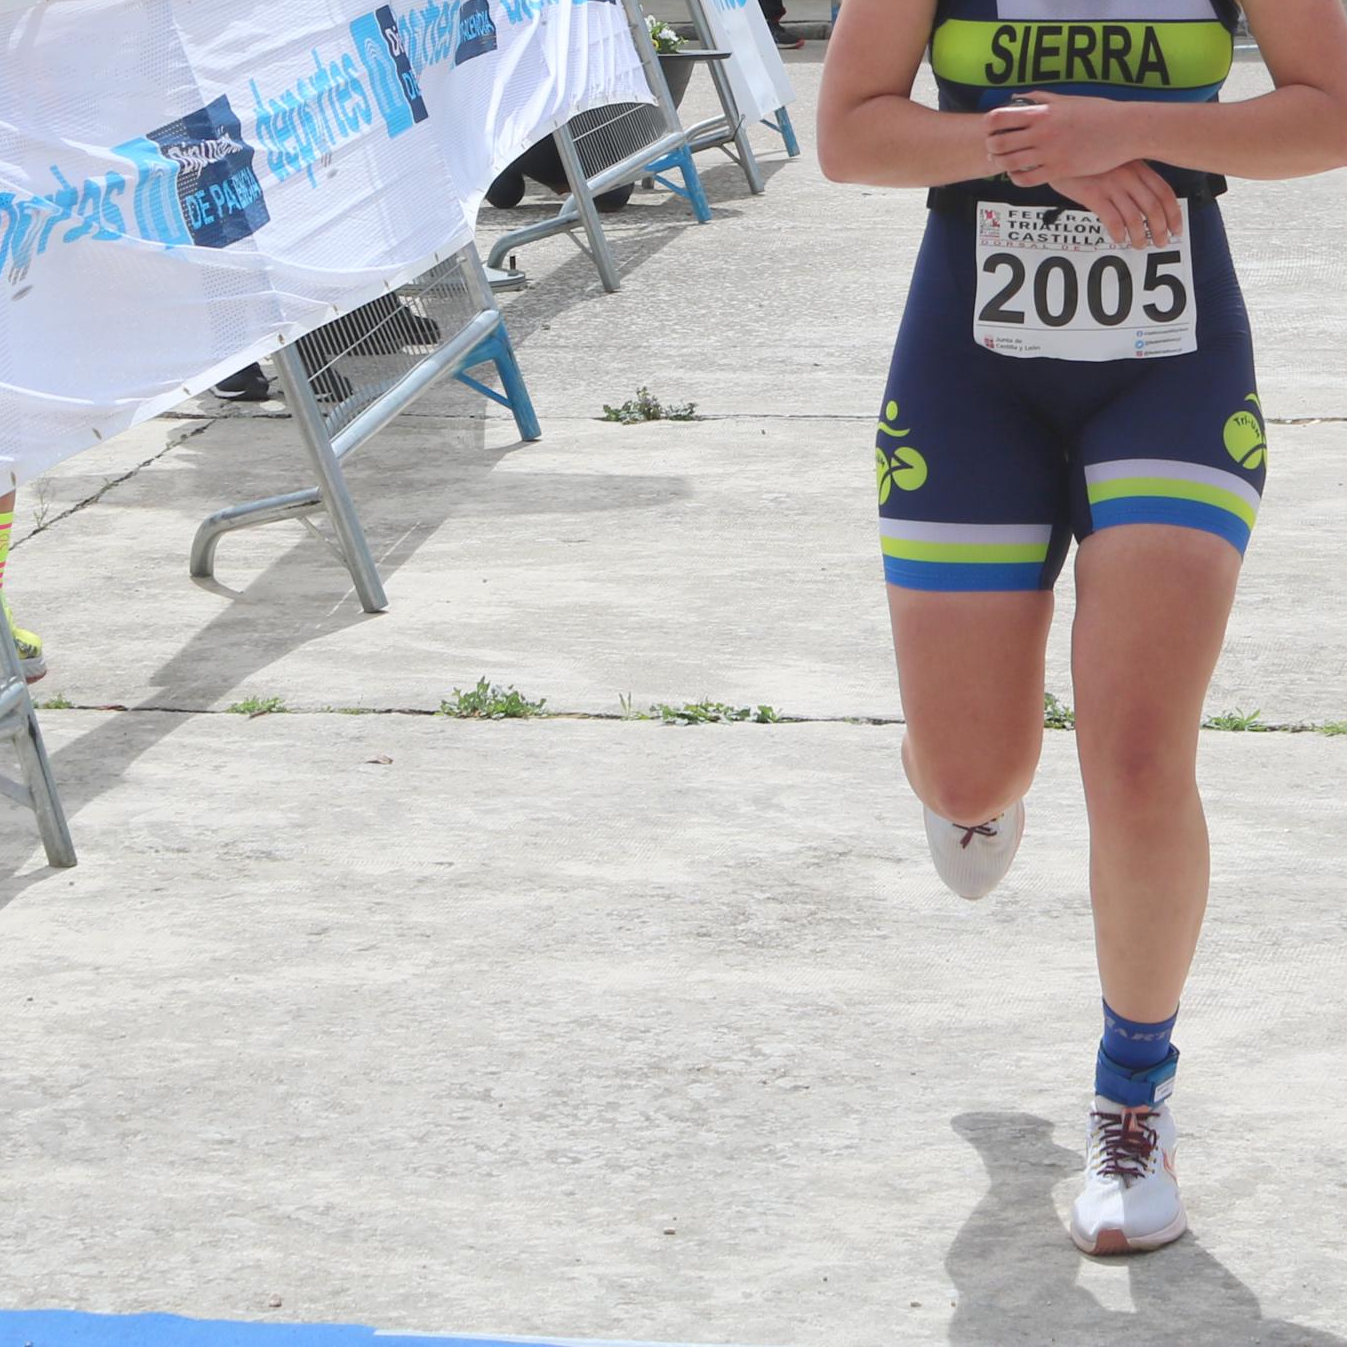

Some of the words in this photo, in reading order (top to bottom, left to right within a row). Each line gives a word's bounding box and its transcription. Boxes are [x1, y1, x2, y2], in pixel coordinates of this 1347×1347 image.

[985, 25, 1171, 85] SIERRA
[1007, 231, 1106, 246] CASTILLA
[978, 251, 1188, 328] 2005
